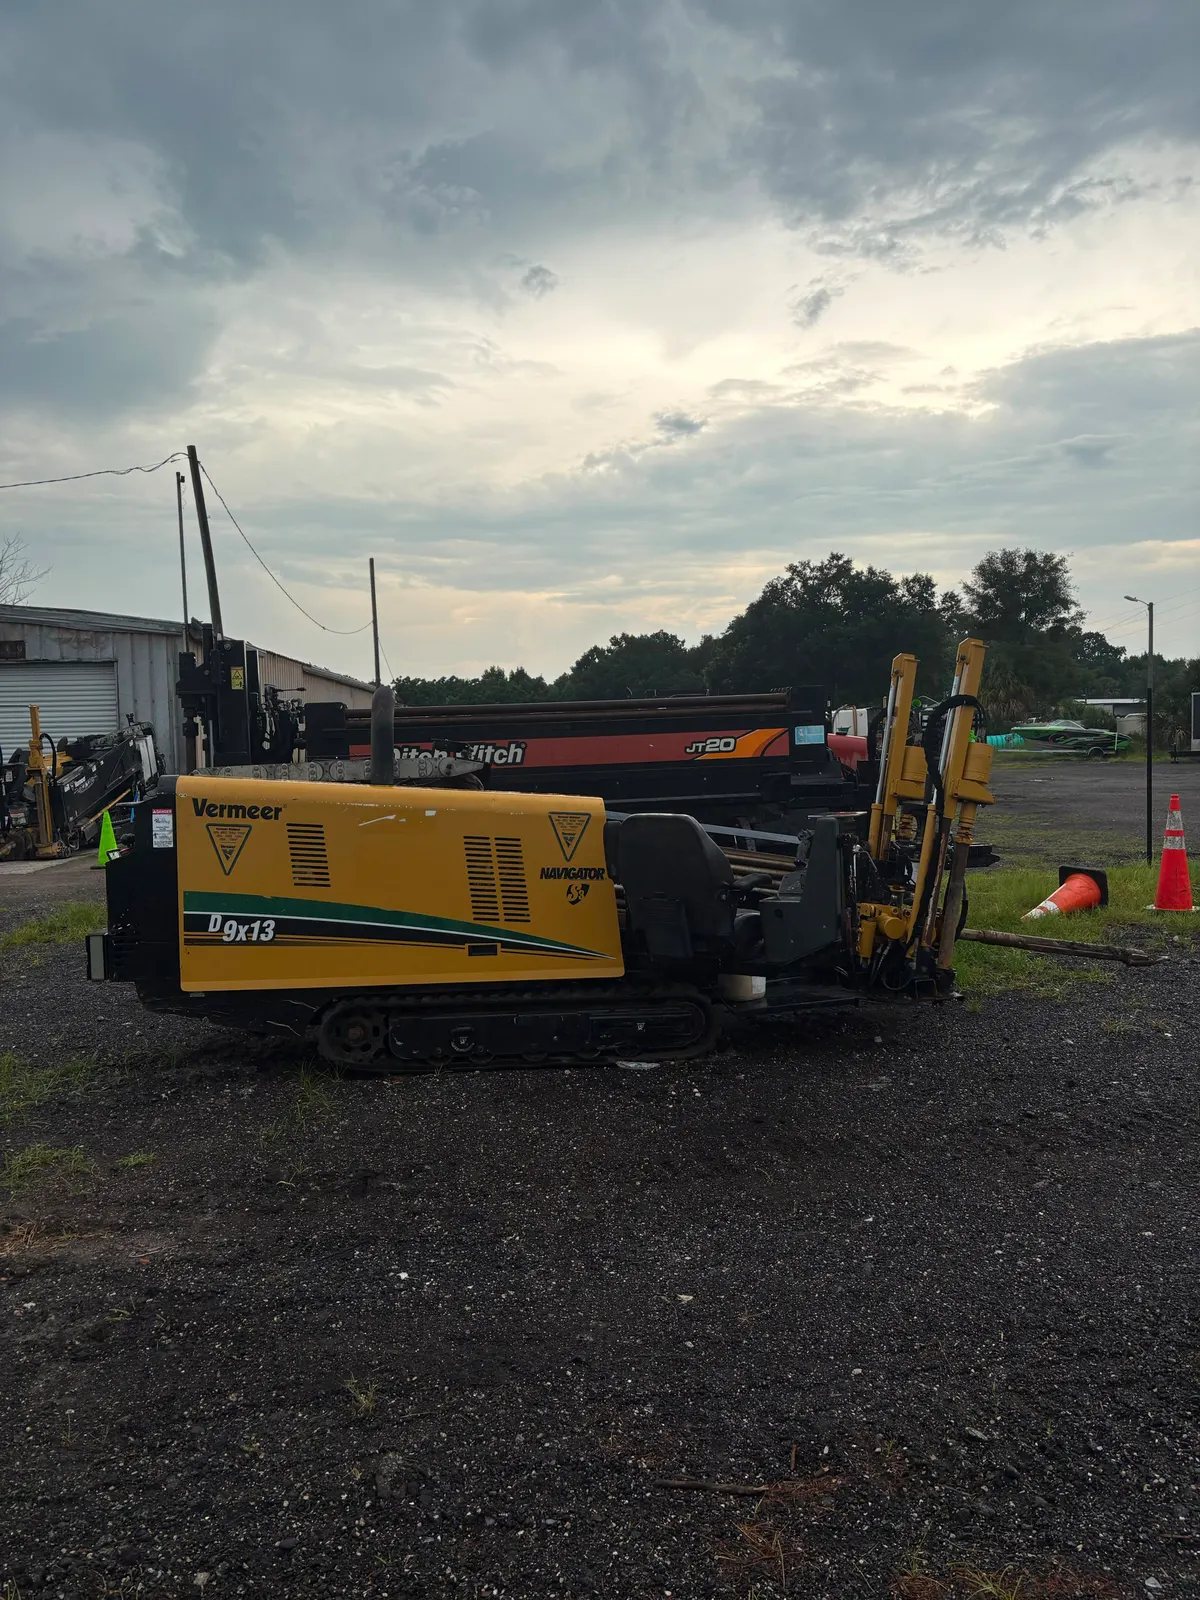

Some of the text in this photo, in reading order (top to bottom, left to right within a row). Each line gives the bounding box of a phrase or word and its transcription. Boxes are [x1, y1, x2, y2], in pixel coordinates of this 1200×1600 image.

[686, 738, 735, 753] JT20
[192, 797, 282, 820] Vermeer
[540, 867, 605, 880] NAVIGATOR
